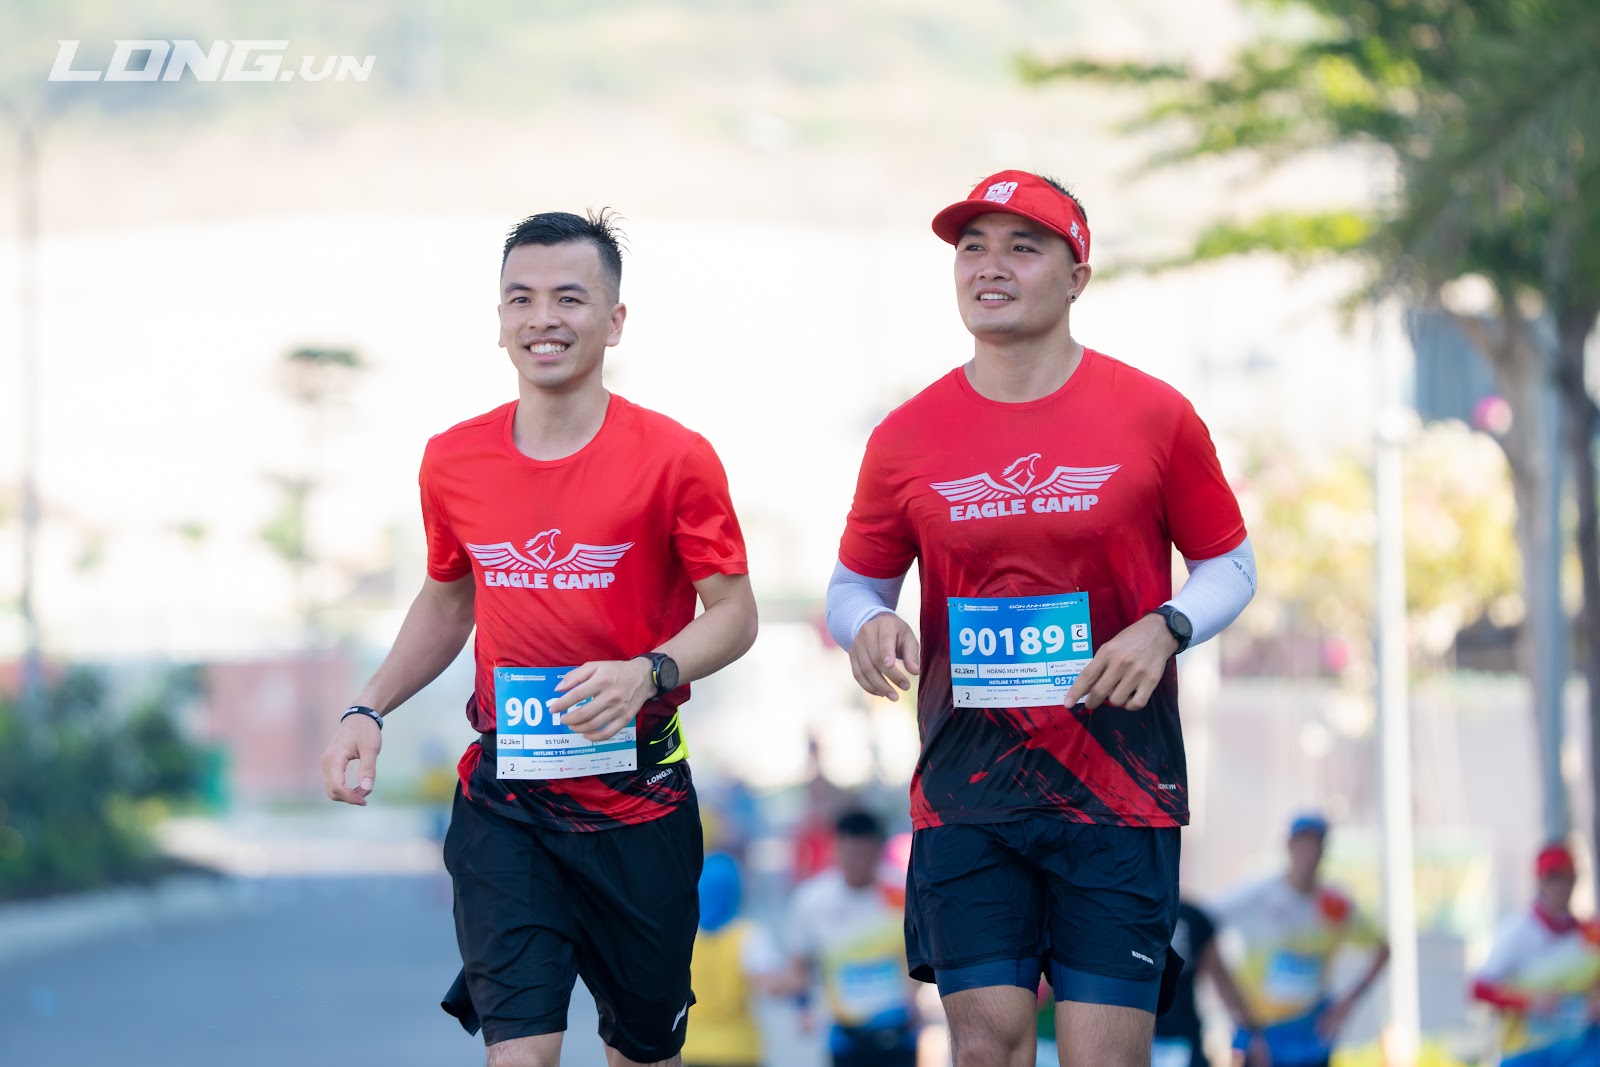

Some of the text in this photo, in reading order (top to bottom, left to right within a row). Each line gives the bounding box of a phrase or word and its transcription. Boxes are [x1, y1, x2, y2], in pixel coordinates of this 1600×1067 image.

[950, 494, 1099, 522] EAGLE CAMP
[484, 571, 616, 590] EAGLE CAMP
[1076, 629, 1083, 638] C
[958, 624, 1065, 656] 90189
[965, 691, 971, 701] 2
[500, 738, 521, 746] 42,2km
[510, 763, 515, 772] 2
